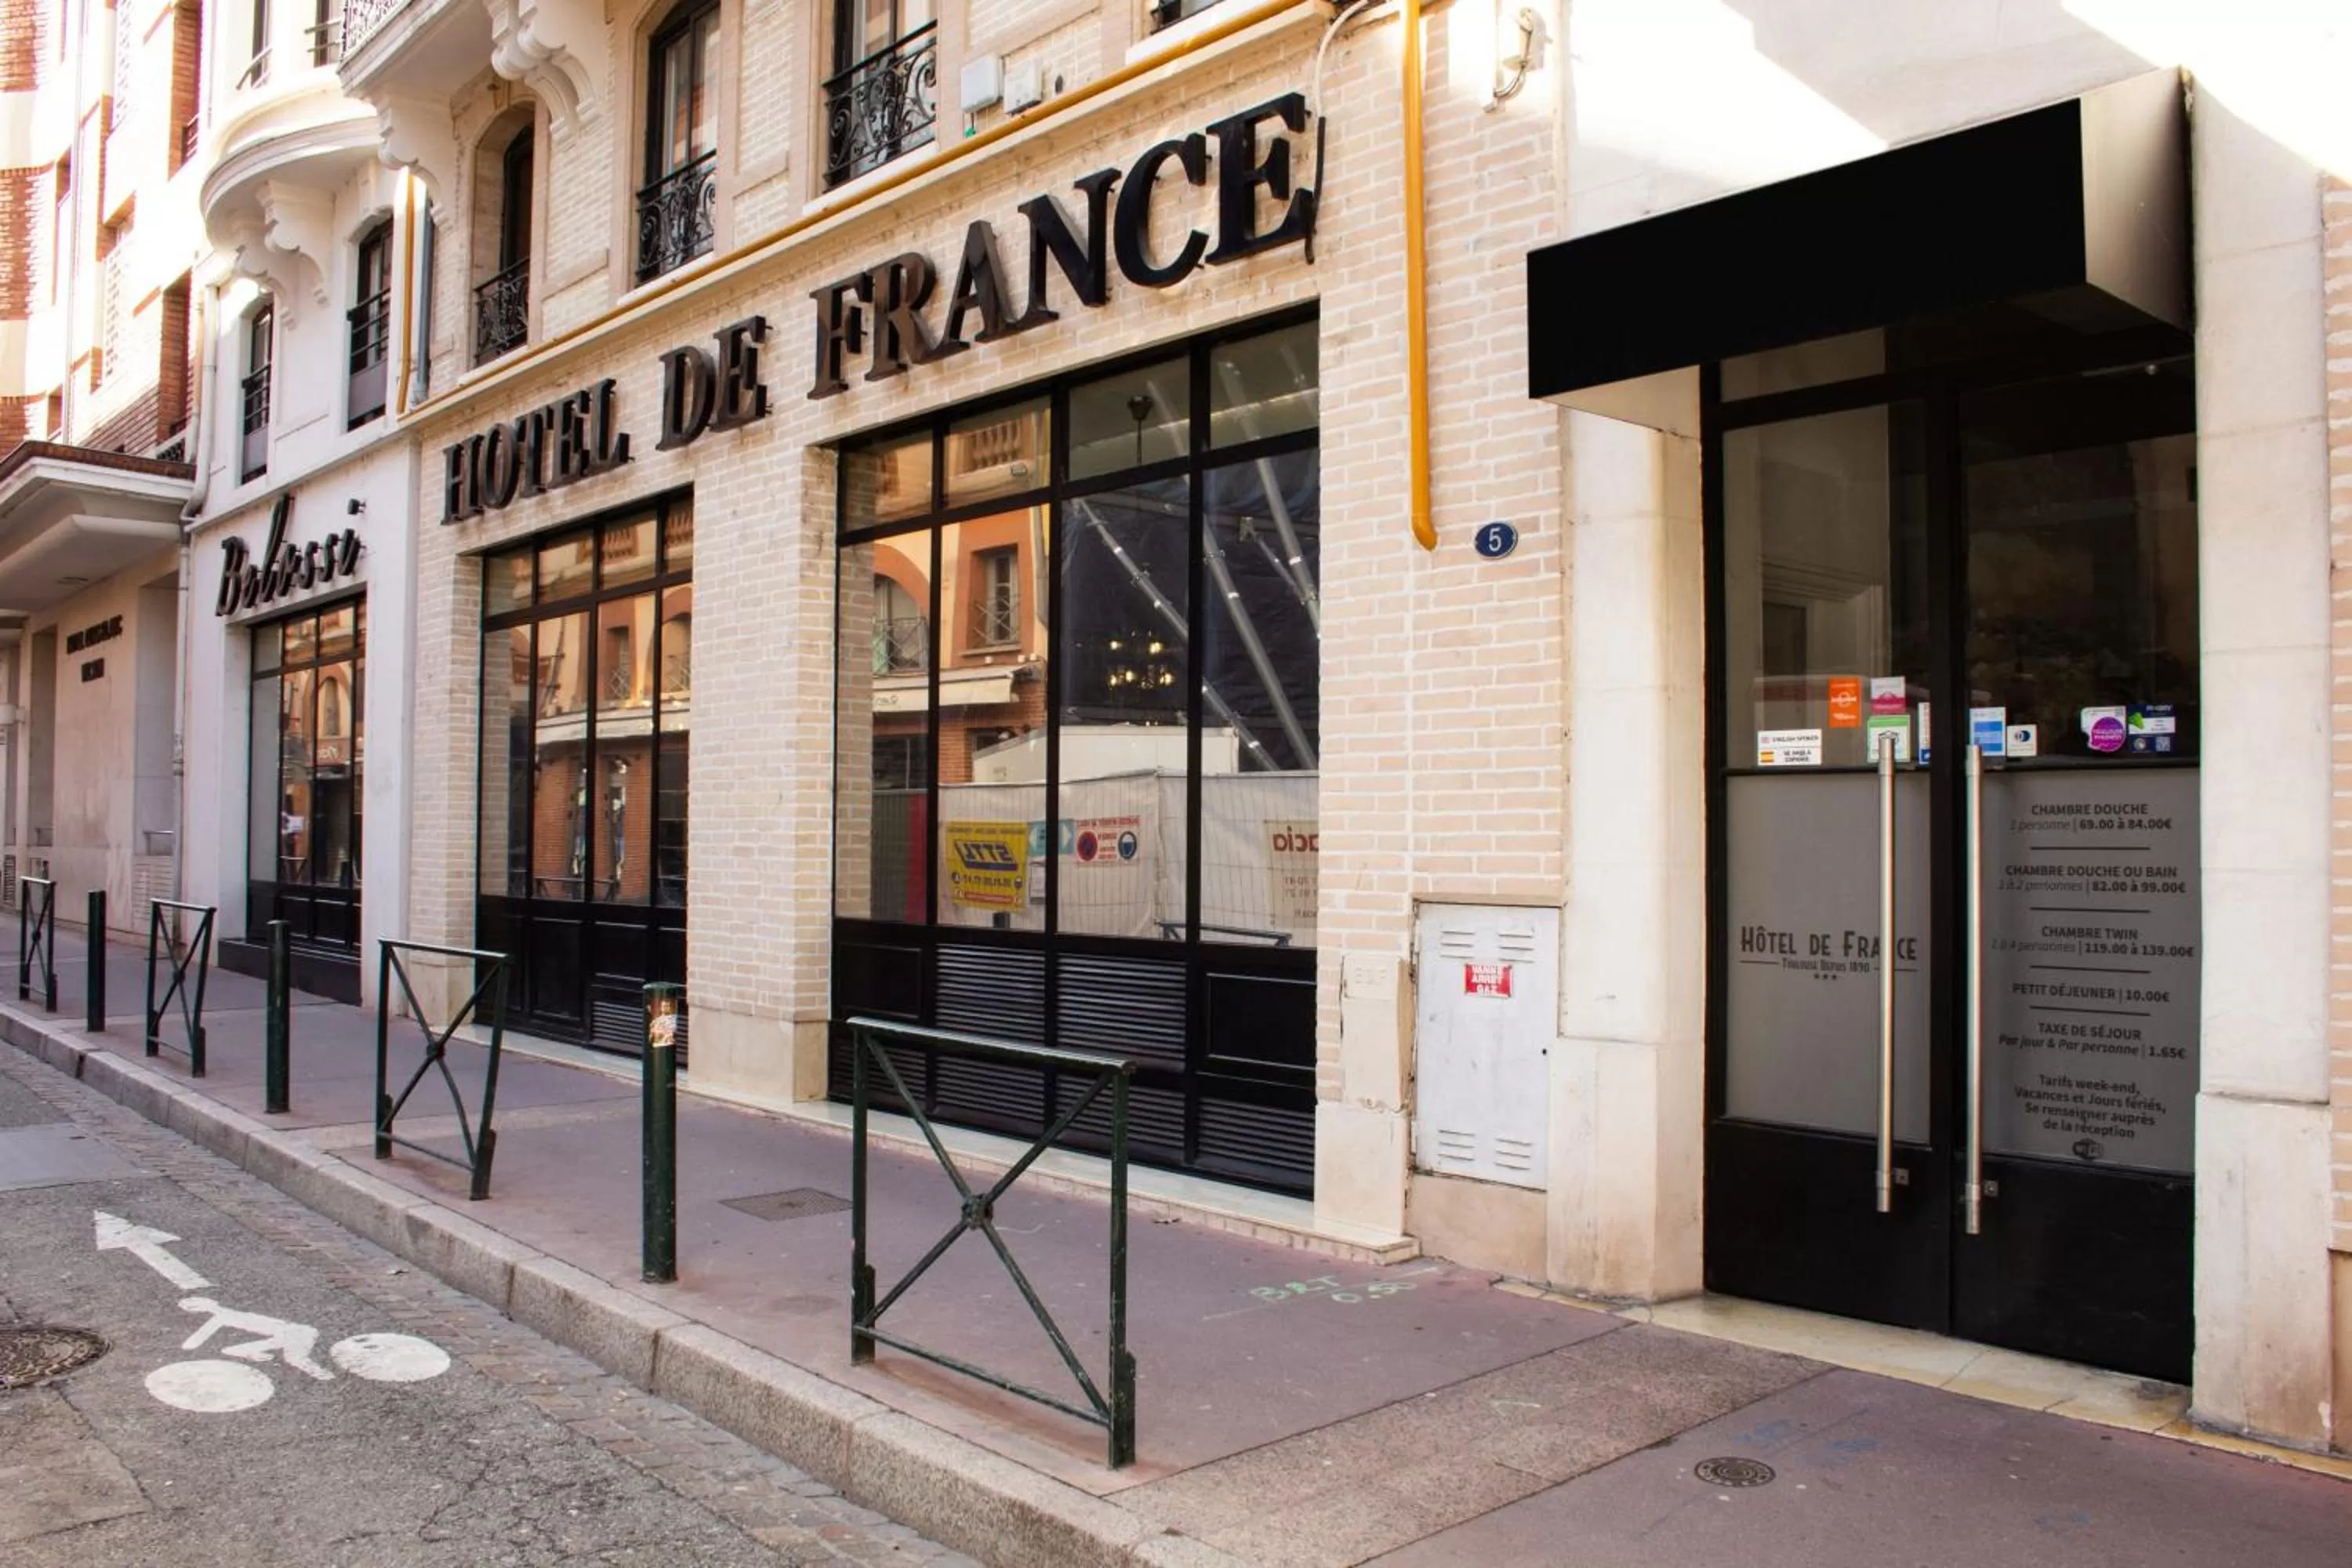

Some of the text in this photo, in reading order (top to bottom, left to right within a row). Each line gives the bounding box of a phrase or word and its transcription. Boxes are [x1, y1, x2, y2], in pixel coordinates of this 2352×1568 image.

[441, 92, 1316, 527] HOTEL DE FRANCE
[1489, 527, 1502, 552] 5
[2031, 804, 2149, 816] CHAMBRE DOUCHE
[2017, 821, 2071, 832] personne
[2005, 865, 2178, 878] CHAMBRE DOUCHE OU BAIN
[2024, 880, 2083, 893] personnes
[2042, 926, 2139, 939] CHAMBRE TWIN
[1740, 925, 1918, 961] HÔTEL DE FRACE
[2013, 982, 2170, 1003] PETIT DÉJEUNER 10.00€
[2038, 1022, 2142, 1040] TAXE DE SÉJOUR
[1999, 1034, 2019, 1045] Par
[2020, 1036, 2045, 1049] jour
[2058, 1039, 2079, 1051] Par
[2082, 1042, 2139, 1055] personne
[2039, 1074, 2074, 1088] Tarifs
[2014, 1086, 2070, 1103] Vacances
[2072, 1093, 2085, 1105] et
[2088, 1094, 2123, 1108] Jours
[2024, 1102, 2039, 1114] Se
[2042, 1106, 2107, 1125] renseigner
[2043, 1119, 2058, 1131] de
[2060, 1120, 2072, 1132] la
